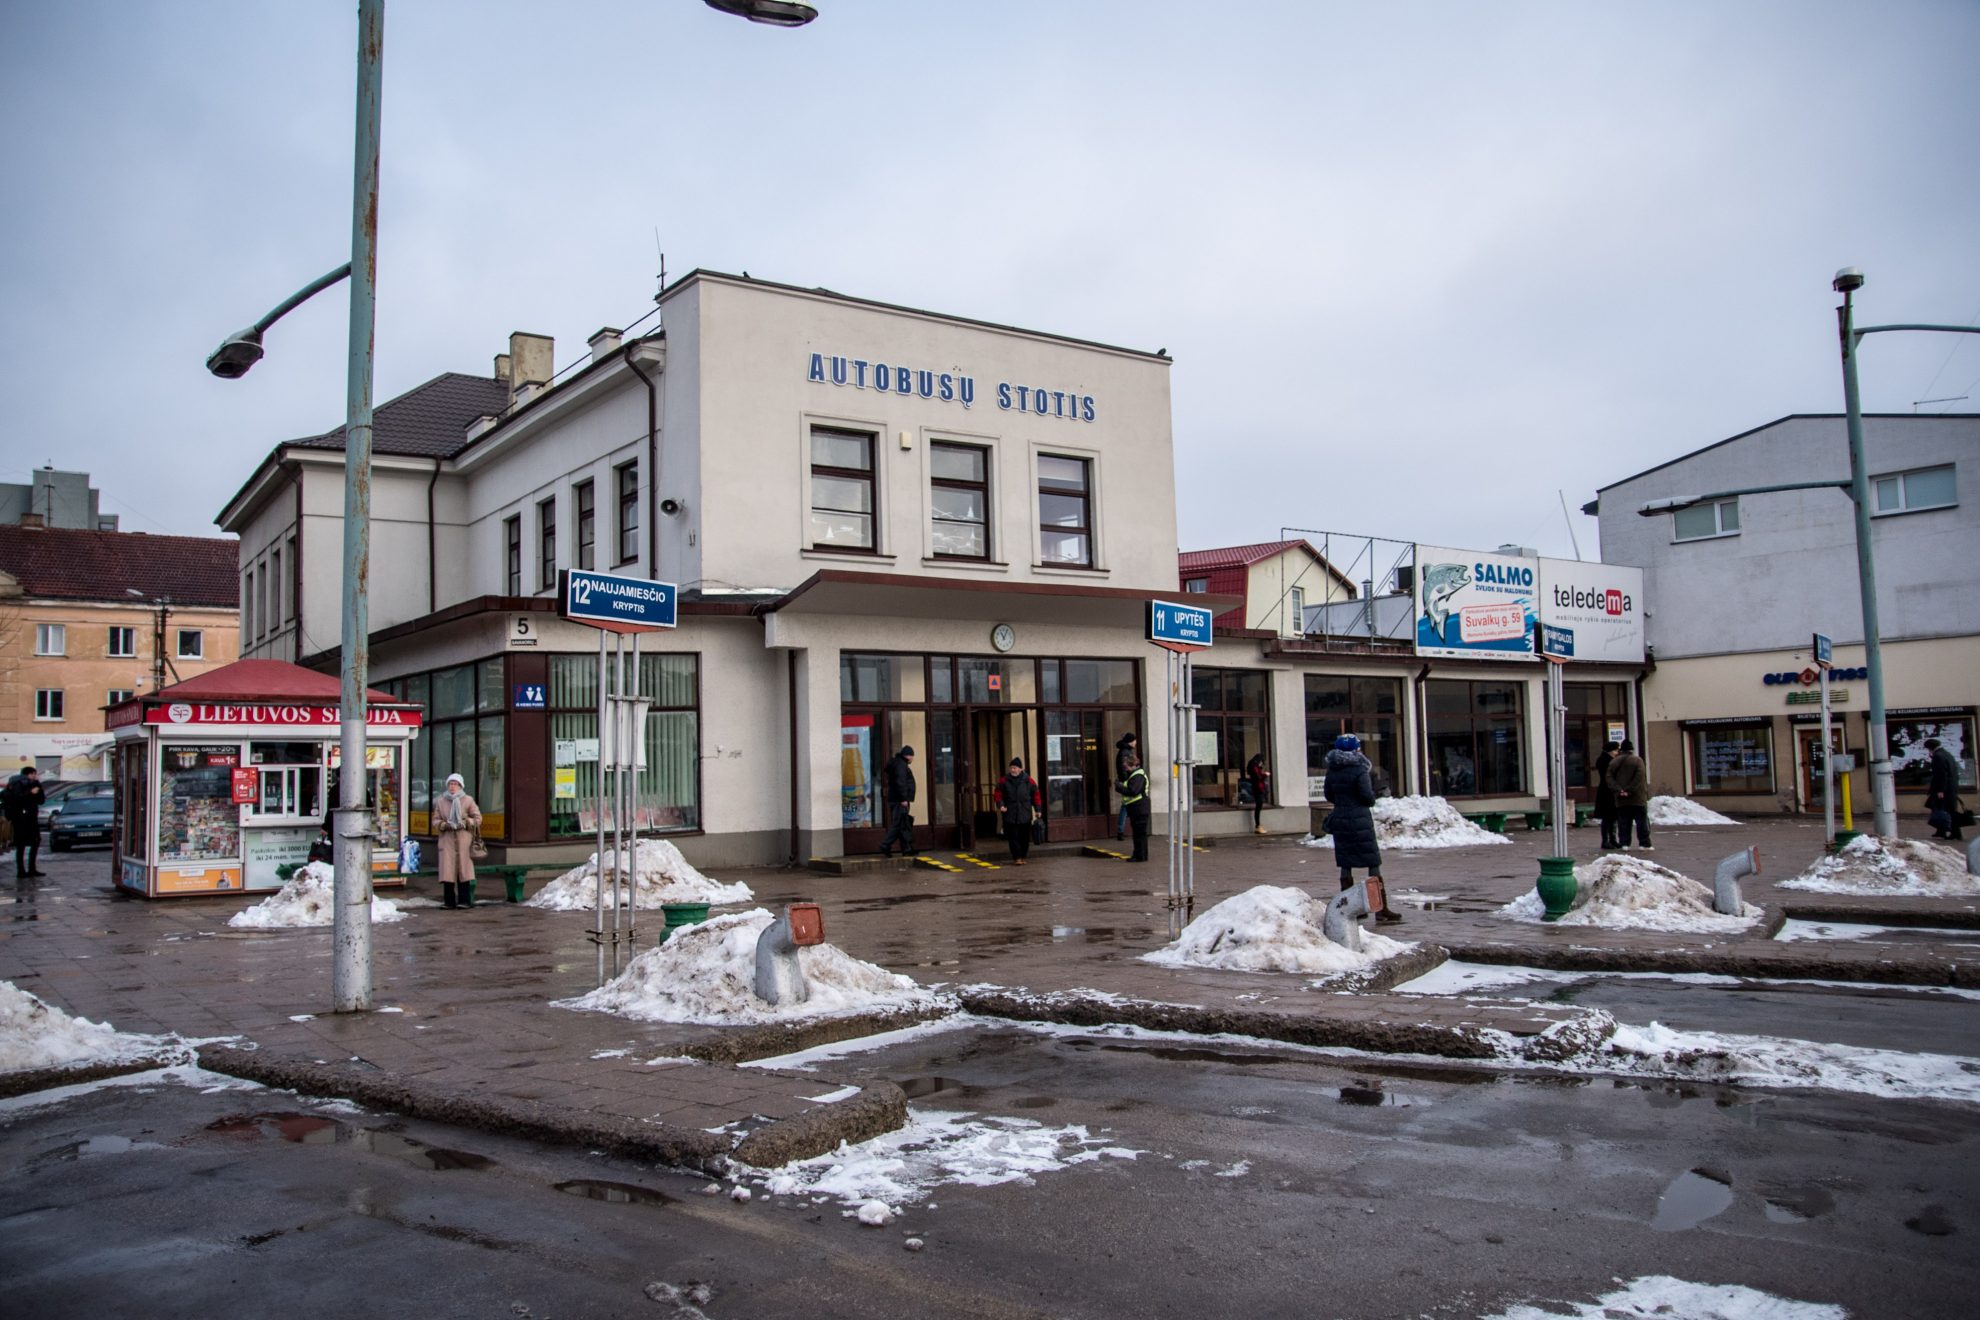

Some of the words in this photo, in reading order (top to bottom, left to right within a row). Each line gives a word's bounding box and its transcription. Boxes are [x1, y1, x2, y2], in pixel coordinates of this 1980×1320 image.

[808, 352, 975, 409] AUTOBUSŲ
[998, 382, 1096, 422] STOTIS
[1475, 562, 1533, 587] SALMO
[572, 578, 591, 605] 12
[591, 580, 666, 603] NAUJAMIESČIO
[1554, 584, 1632, 612] teledema
[613, 600, 645, 614] KRYPTIS
[517, 617, 529, 634] 5
[1156, 609, 1165, 631] 11
[1174, 611, 1204, 627] UPYTĖS
[1465, 614, 1500, 627] Suvalkų
[1501, 616, 1510, 627] g.
[1511, 612, 1521, 624] 59
[1180, 629, 1199, 638] KRYPTIS
[198, 705, 311, 723] LIETUVOS
